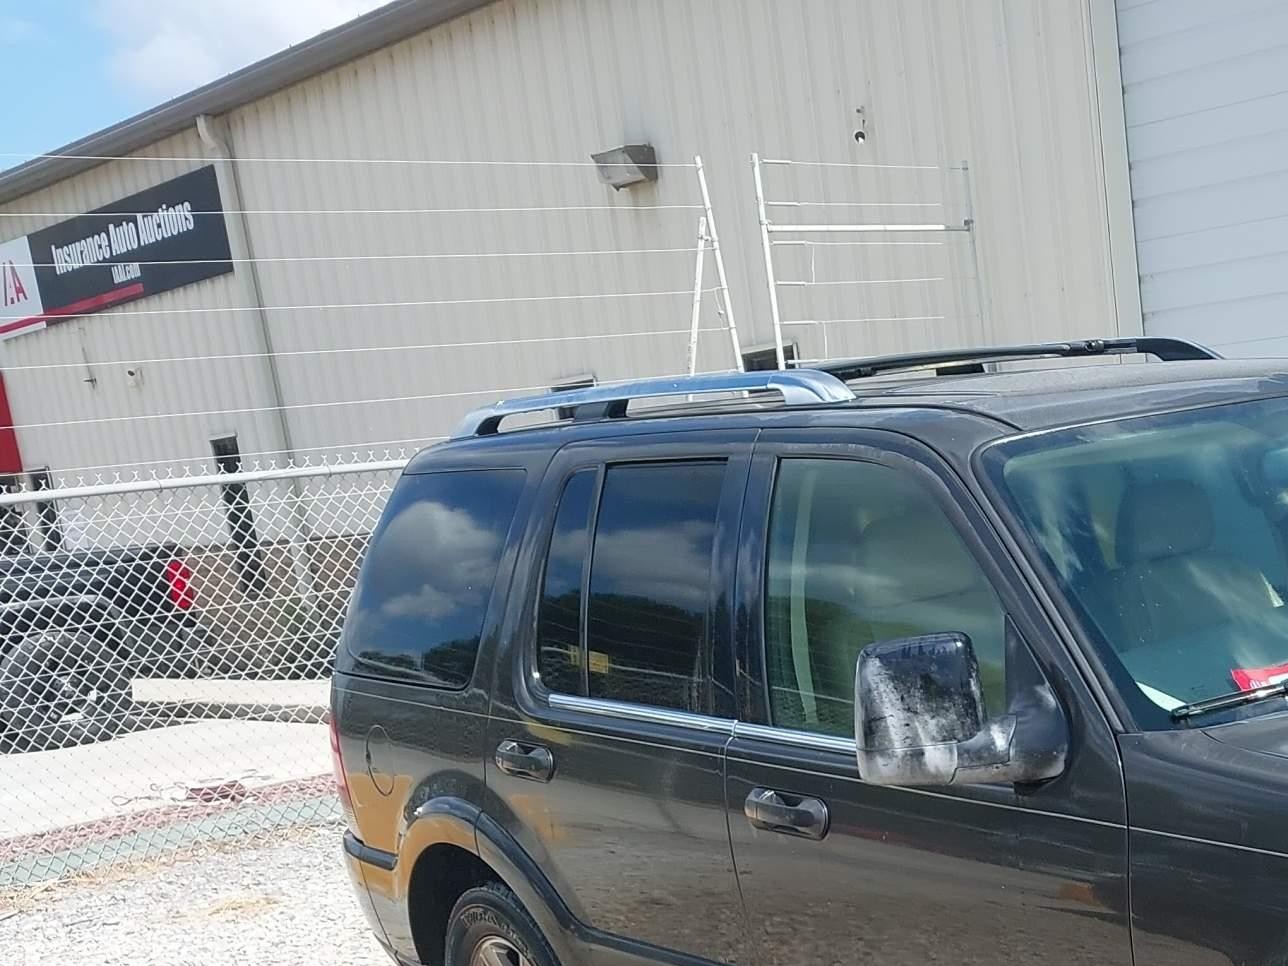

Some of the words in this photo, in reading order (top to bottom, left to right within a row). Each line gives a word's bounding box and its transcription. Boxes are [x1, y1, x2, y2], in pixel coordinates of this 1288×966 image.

[51, 231, 110, 275] Insurance
[108, 221, 139, 256] Auto
[136, 201, 194, 246] Auctions
